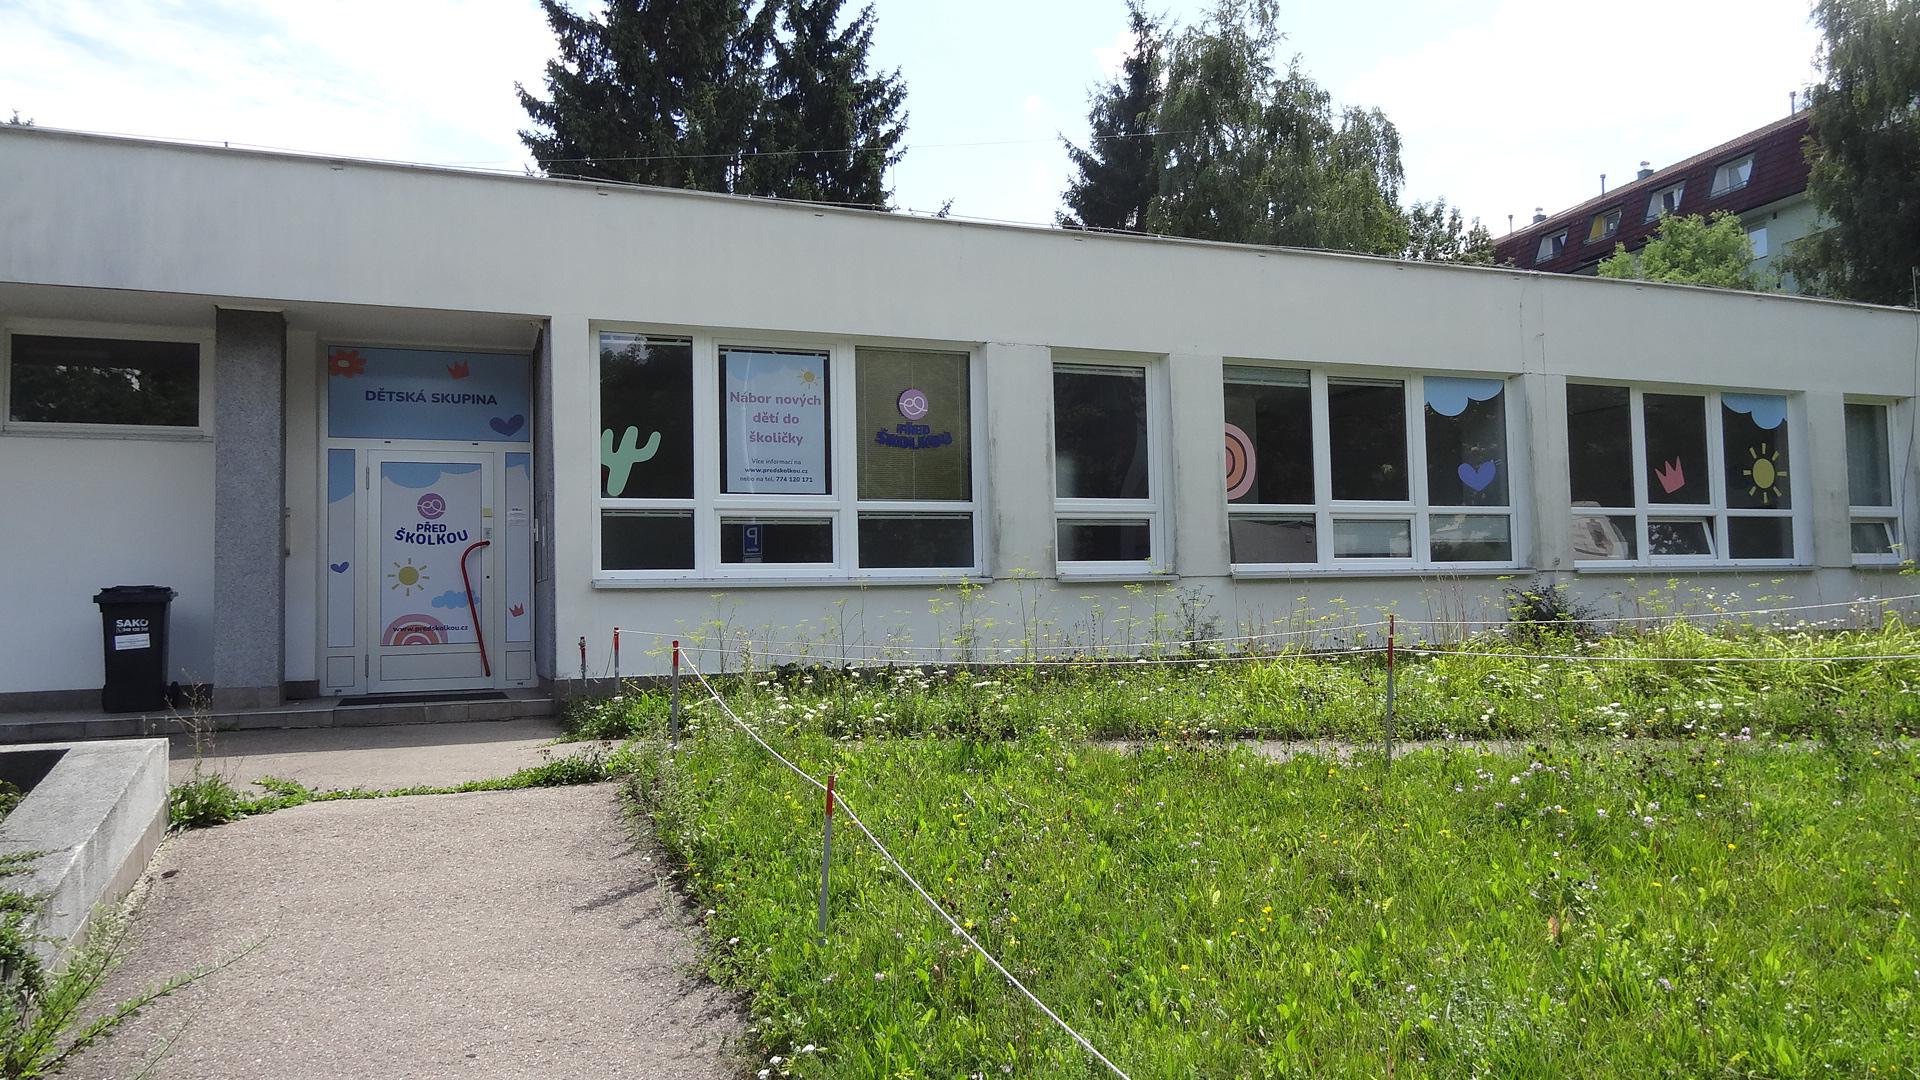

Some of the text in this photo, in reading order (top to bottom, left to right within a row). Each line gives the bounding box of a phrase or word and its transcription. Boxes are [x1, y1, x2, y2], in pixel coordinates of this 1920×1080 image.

[365, 387, 498, 406] DĚTSKÁ SKUPINA
[729, 391, 821, 408] Nábor nových
[752, 411, 800, 425] dětí do
[896, 421, 930, 436] PŘED
[749, 430, 804, 446] školičky
[875, 427, 953, 449] ŠKOLKOU
[416, 521, 447, 533] PŘED
[394, 527, 469, 546] ŠKOLKOU
[115, 619, 149, 627] SAKO
[392, 624, 469, 633] www.predskolkou.cz
